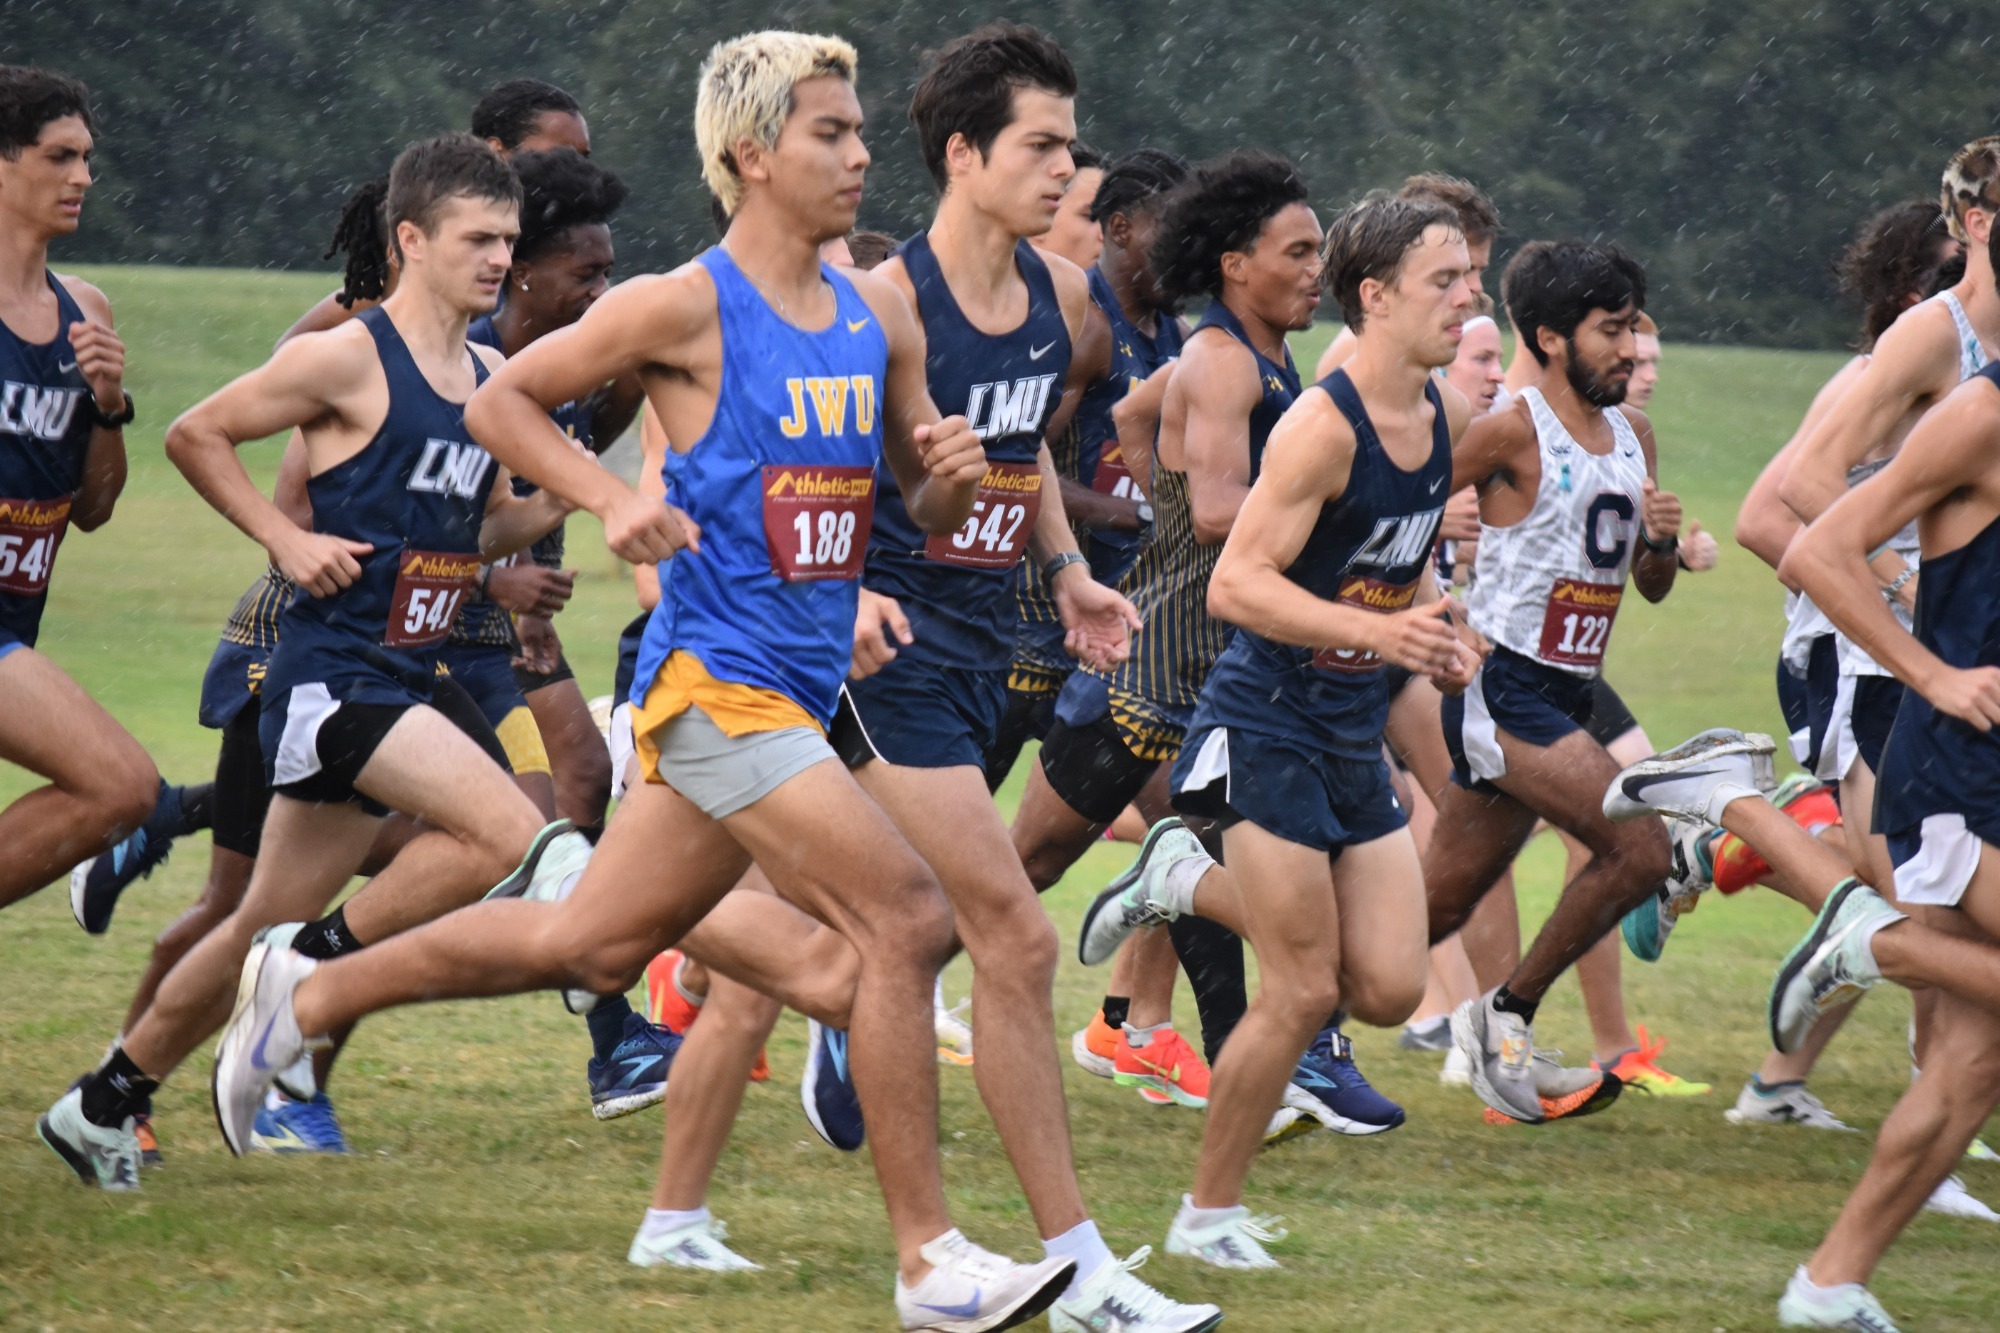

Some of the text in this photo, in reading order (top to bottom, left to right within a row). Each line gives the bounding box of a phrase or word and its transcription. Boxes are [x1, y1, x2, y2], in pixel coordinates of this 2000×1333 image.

[0, 380, 87, 440] LMU
[780, 375, 875, 438] JWU
[965, 373, 1058, 442] LMU
[406, 437, 492, 499] LMU
[980, 466, 1024, 489] hletic
[794, 510, 856, 565] 188
[953, 501, 1025, 551] 542
[1347, 505, 1444, 572] LMU
[1583, 490, 1636, 570] C
[404, 588, 461, 634] 541
[1557, 613, 1609, 655] 122
